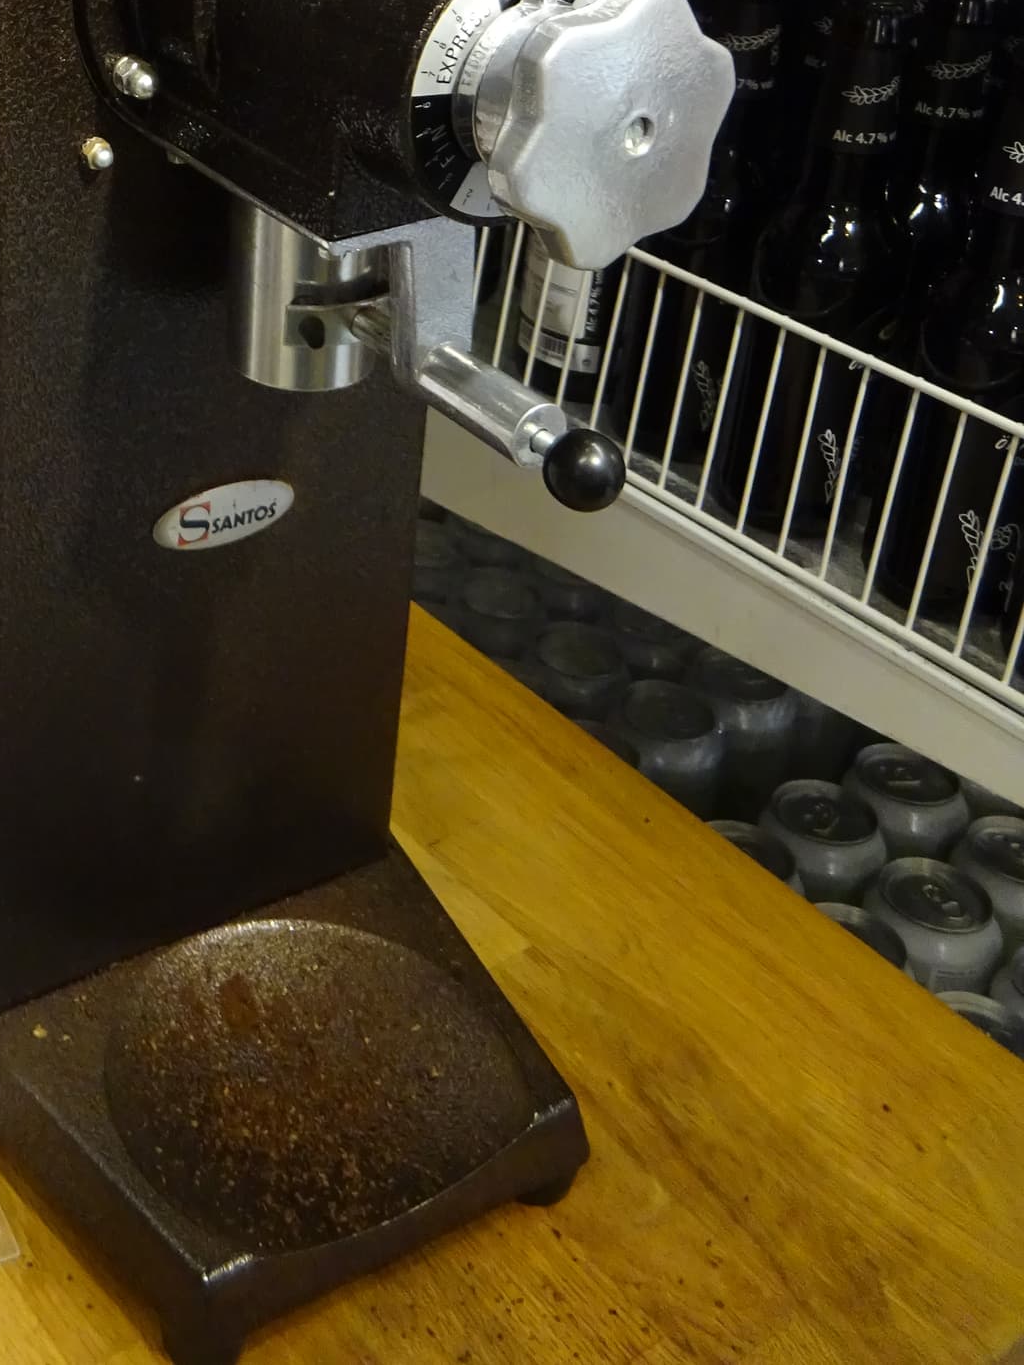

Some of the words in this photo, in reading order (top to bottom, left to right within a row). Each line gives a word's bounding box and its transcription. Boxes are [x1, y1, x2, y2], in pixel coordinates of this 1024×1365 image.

[832, 129, 854, 144] Alc
[989, 186, 1010, 203] Alc
[211, 501, 278, 535] SANTOS
